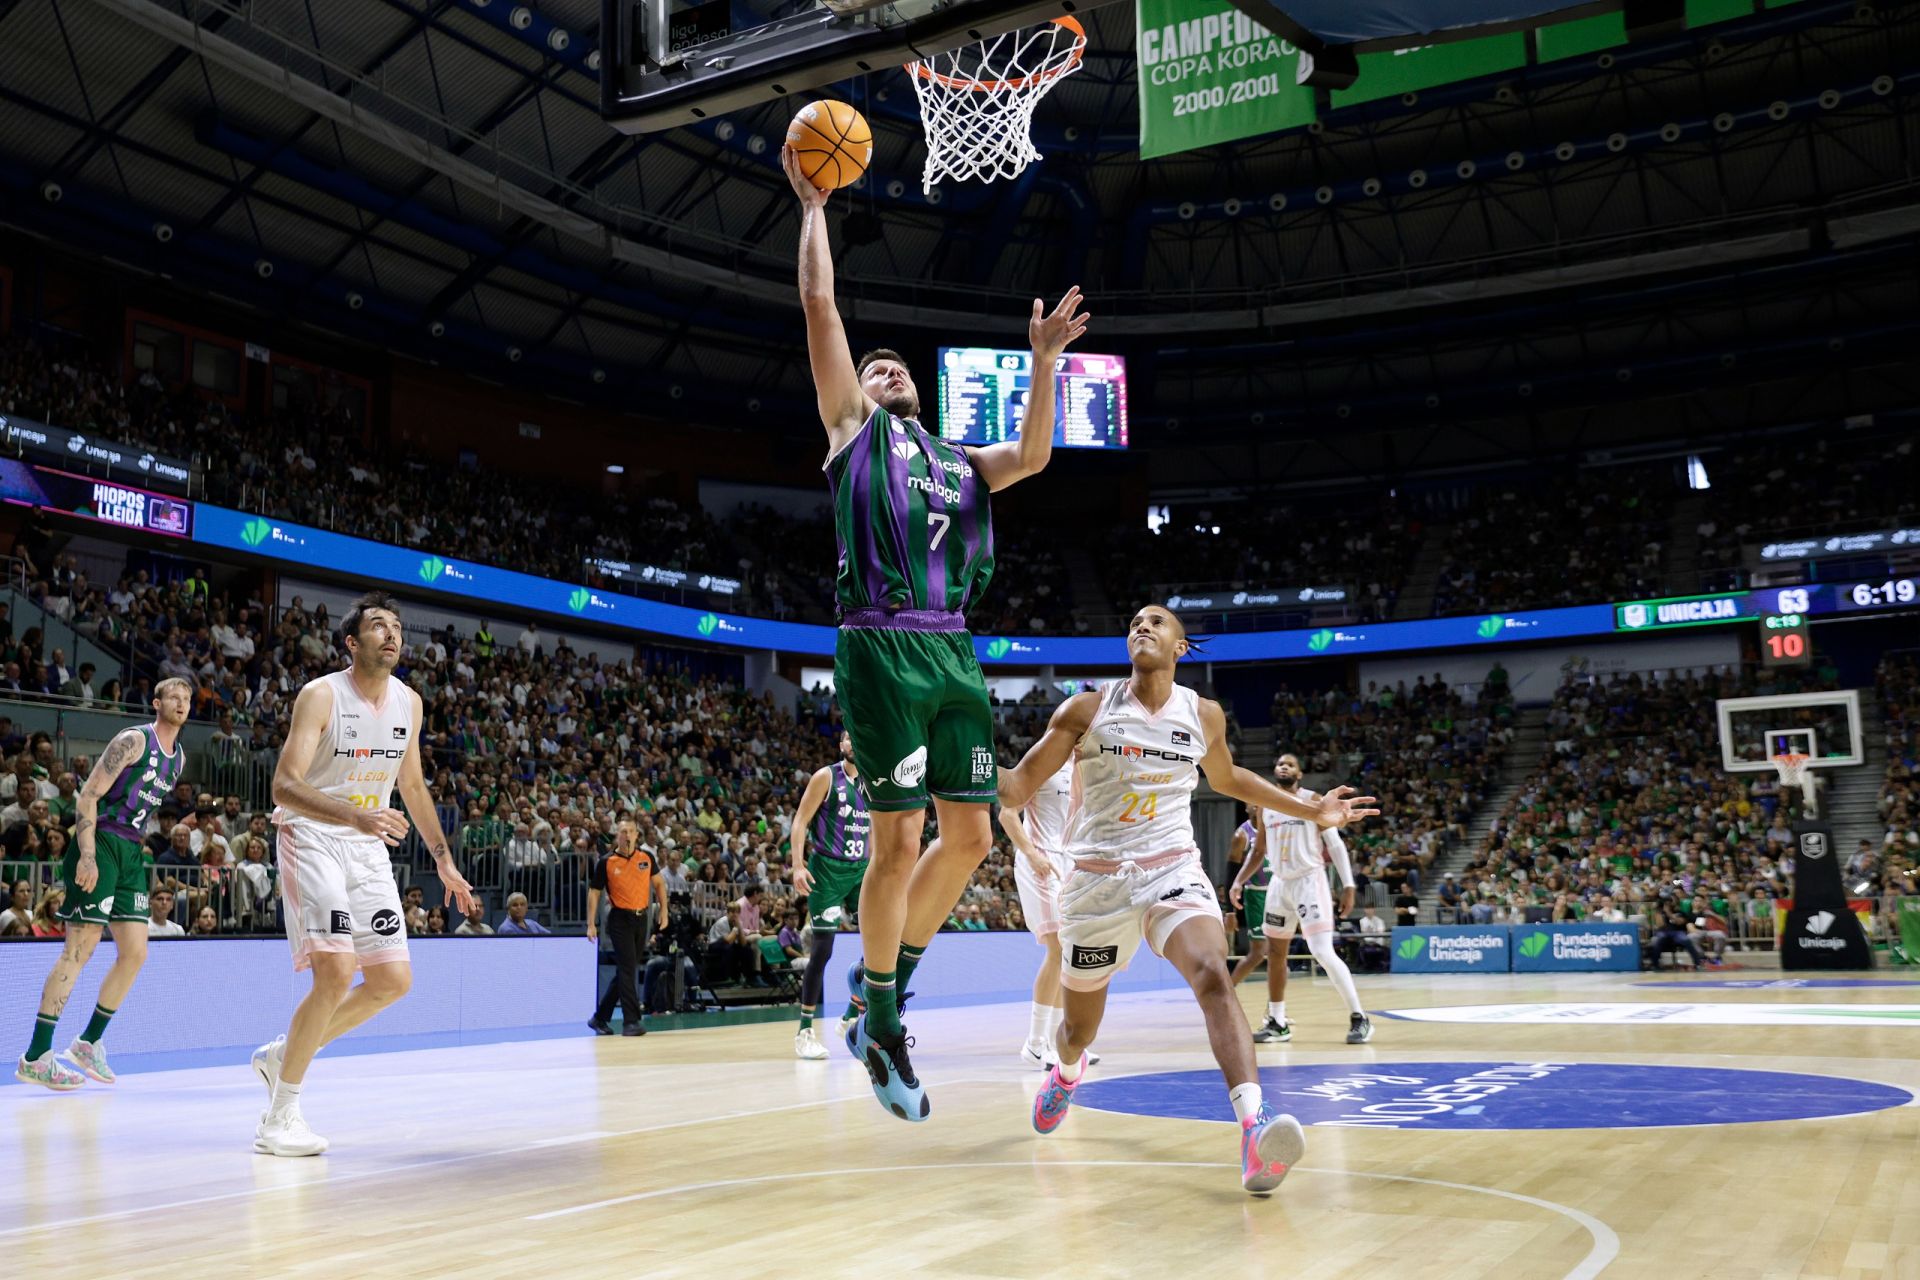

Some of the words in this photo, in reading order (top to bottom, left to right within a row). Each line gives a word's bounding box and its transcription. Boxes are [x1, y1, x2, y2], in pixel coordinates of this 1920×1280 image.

[672, 23, 697, 39] liga
[1151, 55, 1213, 86] COPA
[1173, 73, 1280, 117] 2000/2001
[93, 484, 145, 510] HIOPOS
[907, 476, 960, 504] málaga
[97, 502, 144, 527] LLEIDA
[927, 512, 950, 551] 7
[1853, 579, 1917, 606] 6:19
[1658, 599, 1738, 623] UNICAJA
[1778, 588, 1810, 615] 63
[1766, 614, 1801, 629] 6:19
[1767, 634, 1804, 659] 10
[1119, 791, 1158, 823] 24
[131, 808, 147, 830] 2
[844, 839, 865, 858] 33
[1428, 935, 1504, 949] Fundación
[1553, 932, 1633, 947] Fundación
[1798, 936, 1847, 951] Unicaja
[1077, 951, 1110, 965] PONS
[1429, 948, 1483, 964] Unicaja
[1553, 944, 1612, 962] Unicaja
